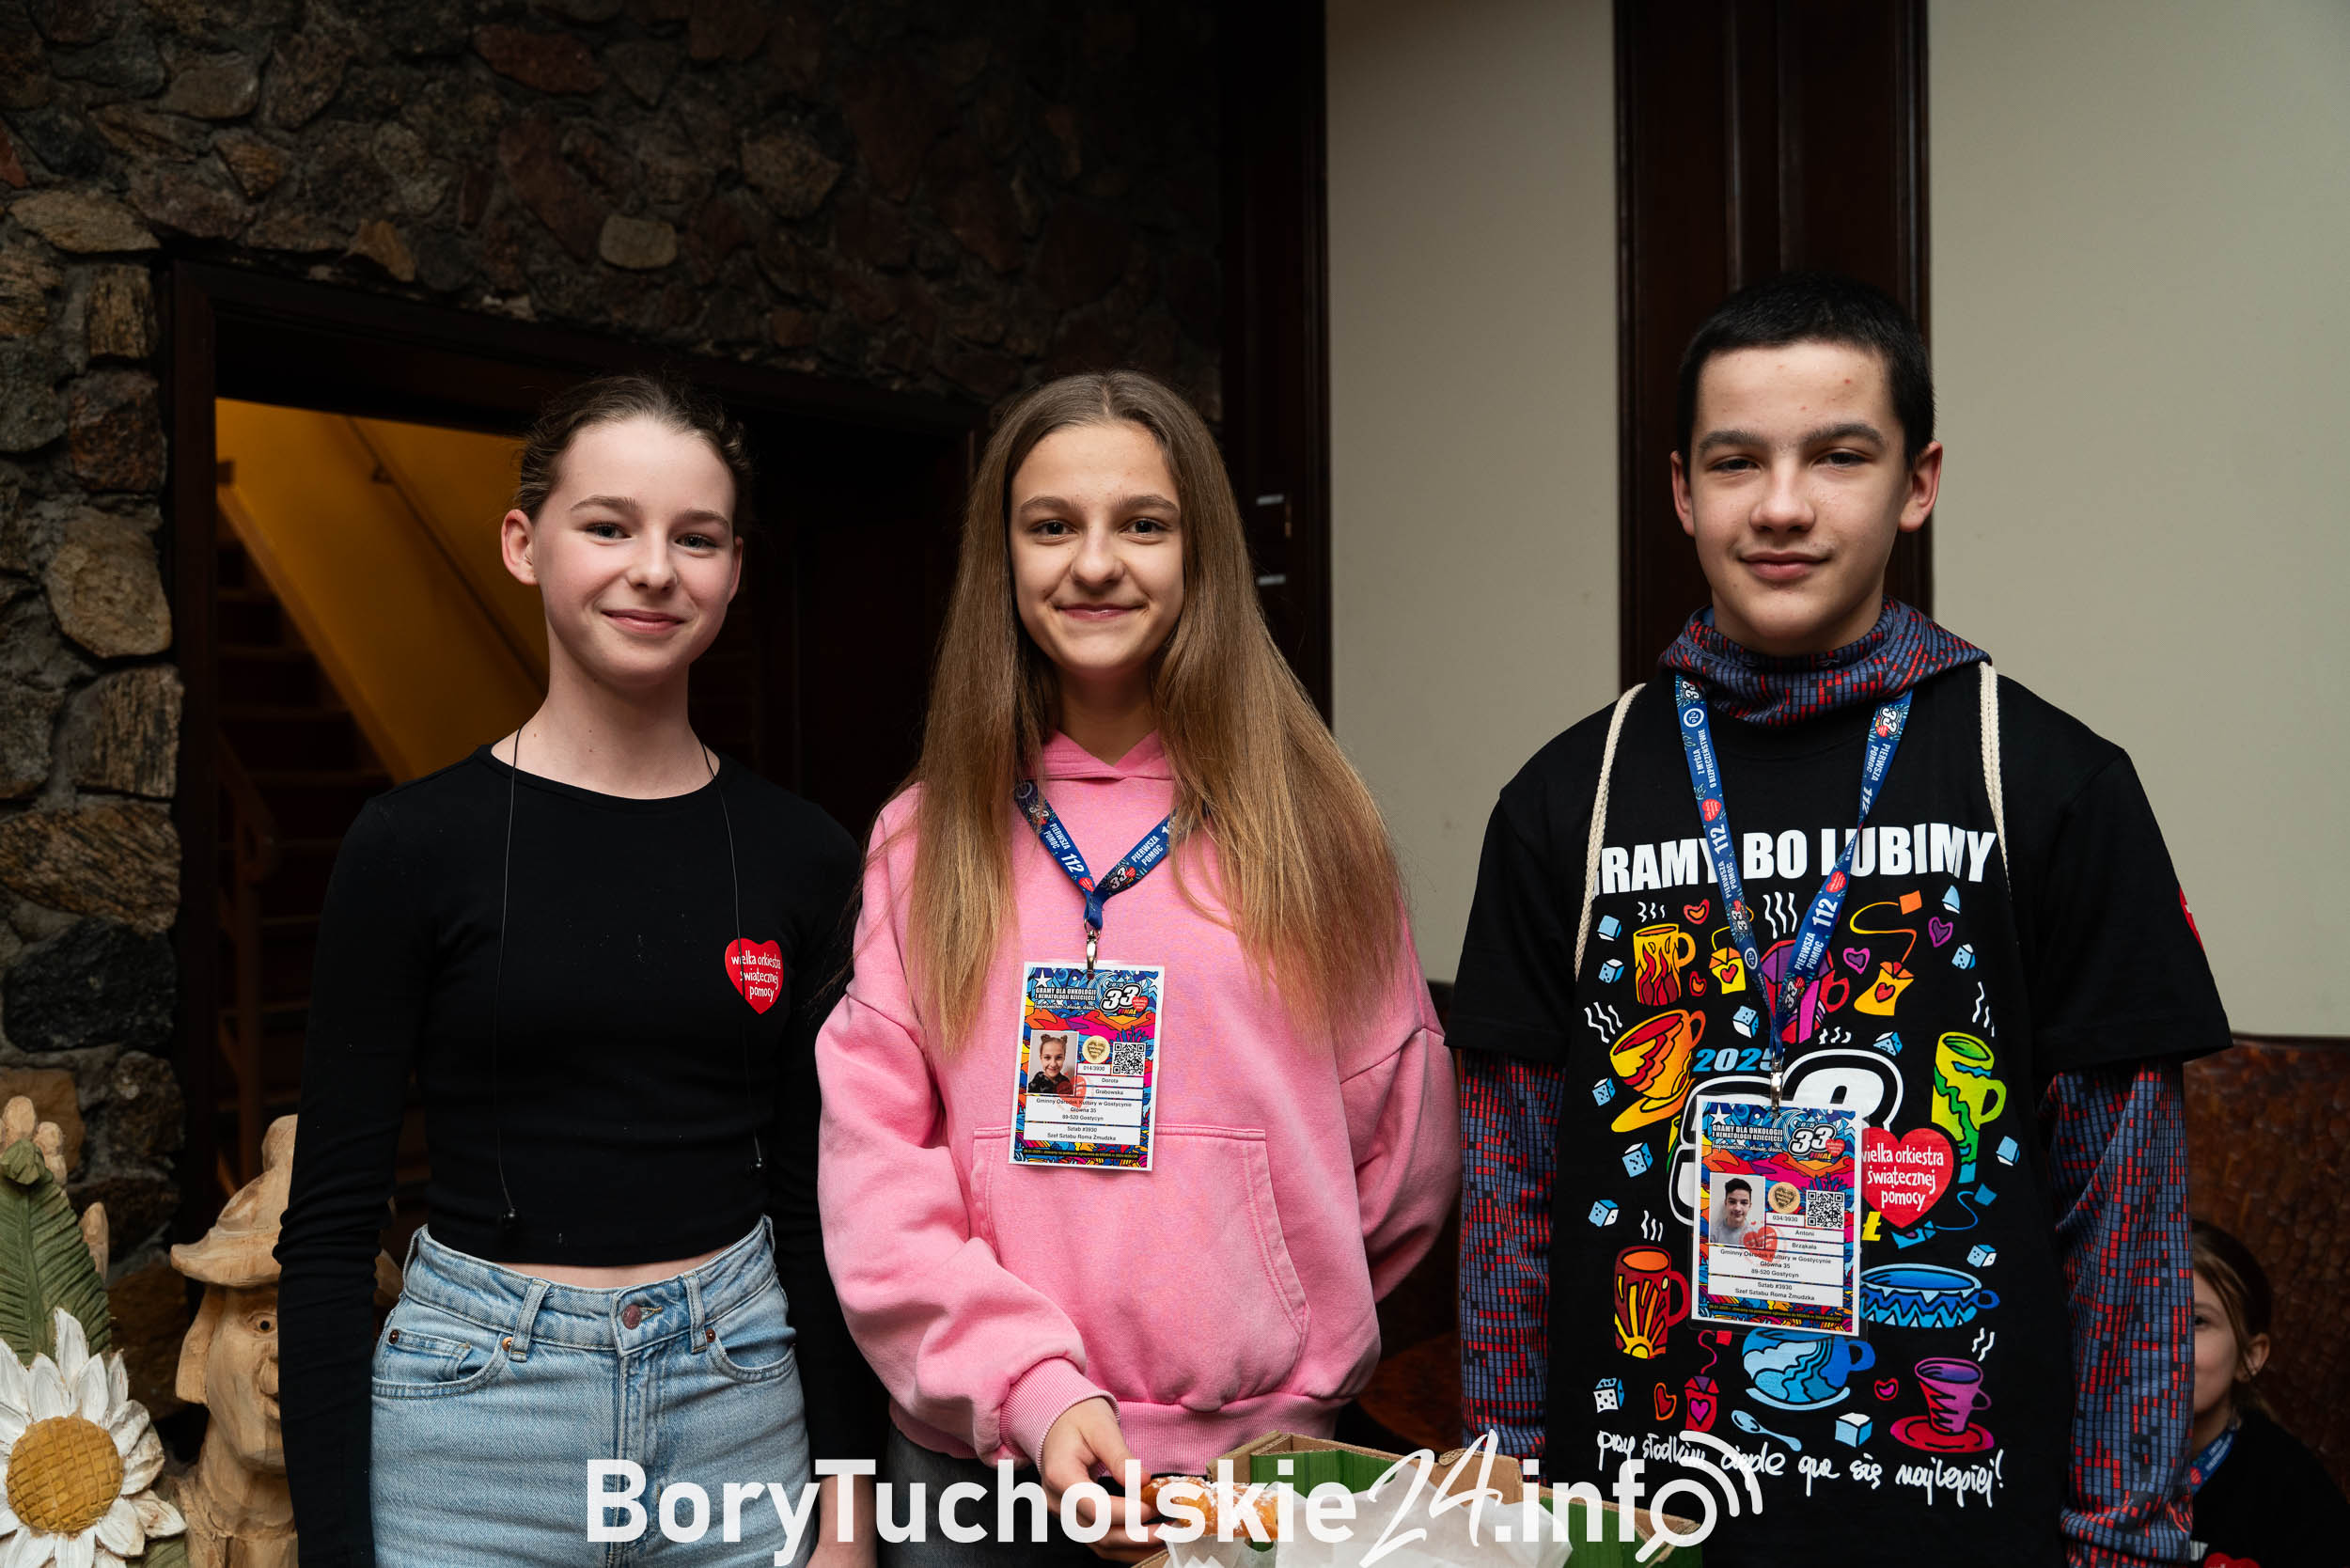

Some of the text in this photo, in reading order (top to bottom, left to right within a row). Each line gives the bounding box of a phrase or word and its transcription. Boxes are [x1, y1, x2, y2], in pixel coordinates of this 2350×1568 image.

[1866, 745, 1879, 772] POMOC
[1871, 743, 1891, 782] PIERWSZA
[1861, 785, 1873, 815] 112
[1043, 830, 1060, 849] POMOC
[1049, 823, 1072, 850] PIERWSZA
[1131, 835, 1160, 863] PIERWSZA
[1710, 823, 1729, 855] 112
[1061, 853, 1085, 873] 112
[1141, 845, 1164, 866] POMOC
[1595, 838, 1718, 897] RAMY
[1743, 829, 1808, 879] BO
[1109, 867, 1128, 888] 33
[1718, 860, 1731, 899] PIERWSZA
[1726, 862, 1737, 889] POMOC
[1811, 898, 1839, 927] 112
[758, 951, 781, 969] orkiestra
[1794, 932, 1816, 970] PIERWSZA
[1806, 940, 1825, 970] POMOC
[749, 986, 775, 1002] pomocy
[1102, 984, 1141, 1011] 33
[1748, 1126, 1783, 1136] ONKOLOGII
[1790, 1125, 1836, 1155] 33
[1895, 1145, 1944, 1166] orkiestra
[1867, 1166, 1936, 1195] świątecznej
[1881, 1190, 1926, 1212] pomocy
[1769, 1253, 1791, 1262] Kultury
[1797, 1256, 1831, 1264] Gostycynie
[1771, 1270, 1799, 1278] Gostycyn
